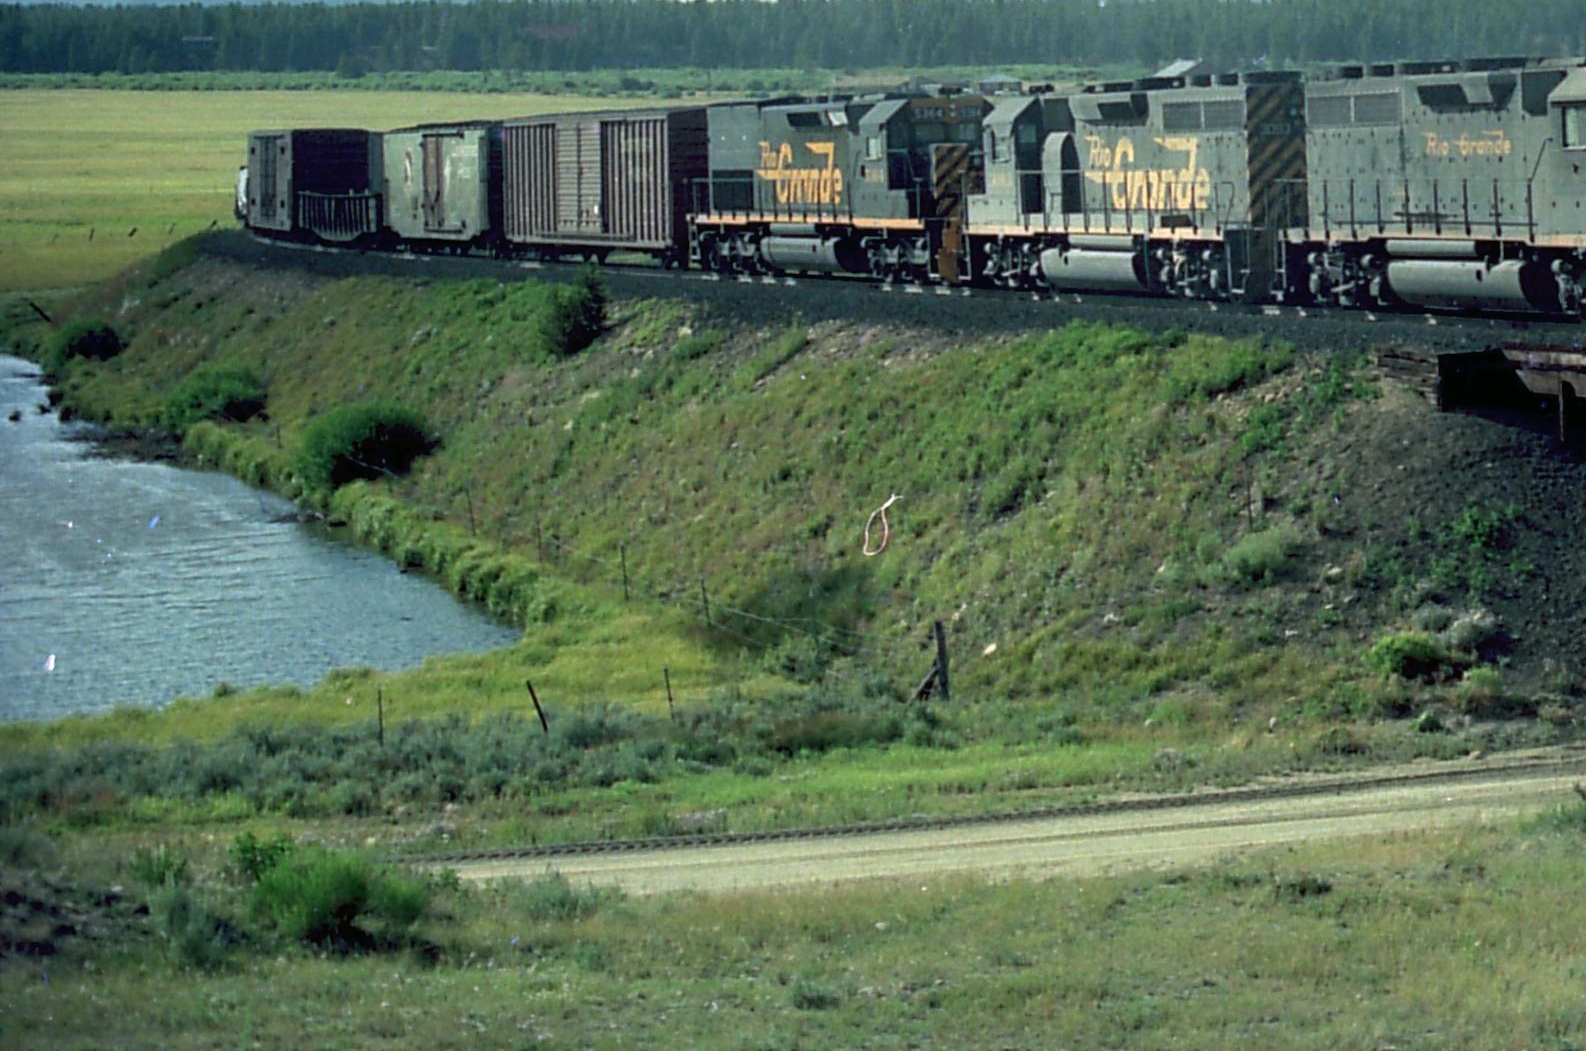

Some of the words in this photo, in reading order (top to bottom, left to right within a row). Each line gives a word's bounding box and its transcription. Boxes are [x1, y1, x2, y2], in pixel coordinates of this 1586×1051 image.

[1084, 135, 1112, 168] Rio
[1422, 132, 1449, 156] Rio
[1453, 129, 1512, 156] Grande
[756, 141, 843, 205] Grande
[1084, 136, 1211, 210] Grande
